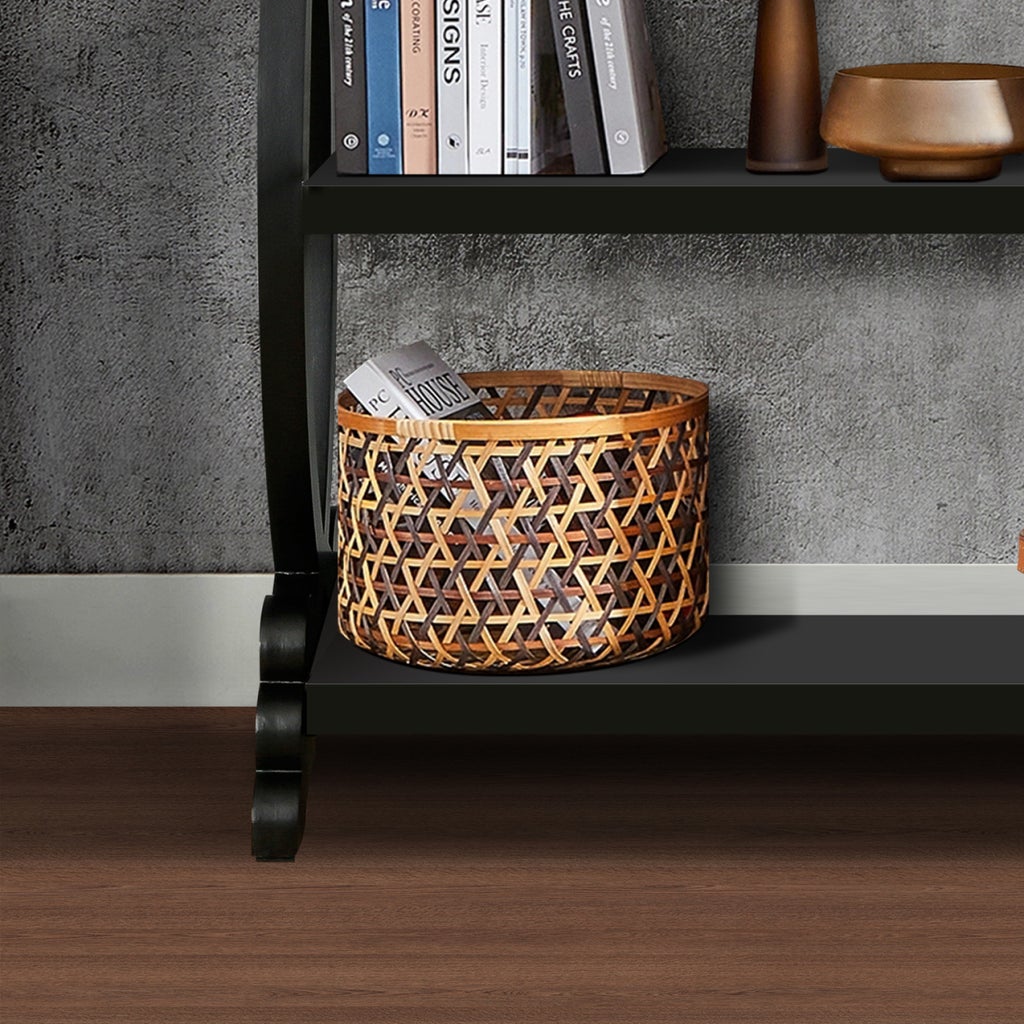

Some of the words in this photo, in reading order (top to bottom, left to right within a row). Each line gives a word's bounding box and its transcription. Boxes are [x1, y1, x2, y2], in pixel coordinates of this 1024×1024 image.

[342, 13, 353, 24] of
[562, 25, 582, 78] CRAFTS
[343, 57, 354, 86] century
[368, 389, 391, 412] PC
[405, 372, 470, 416] HOUSE
